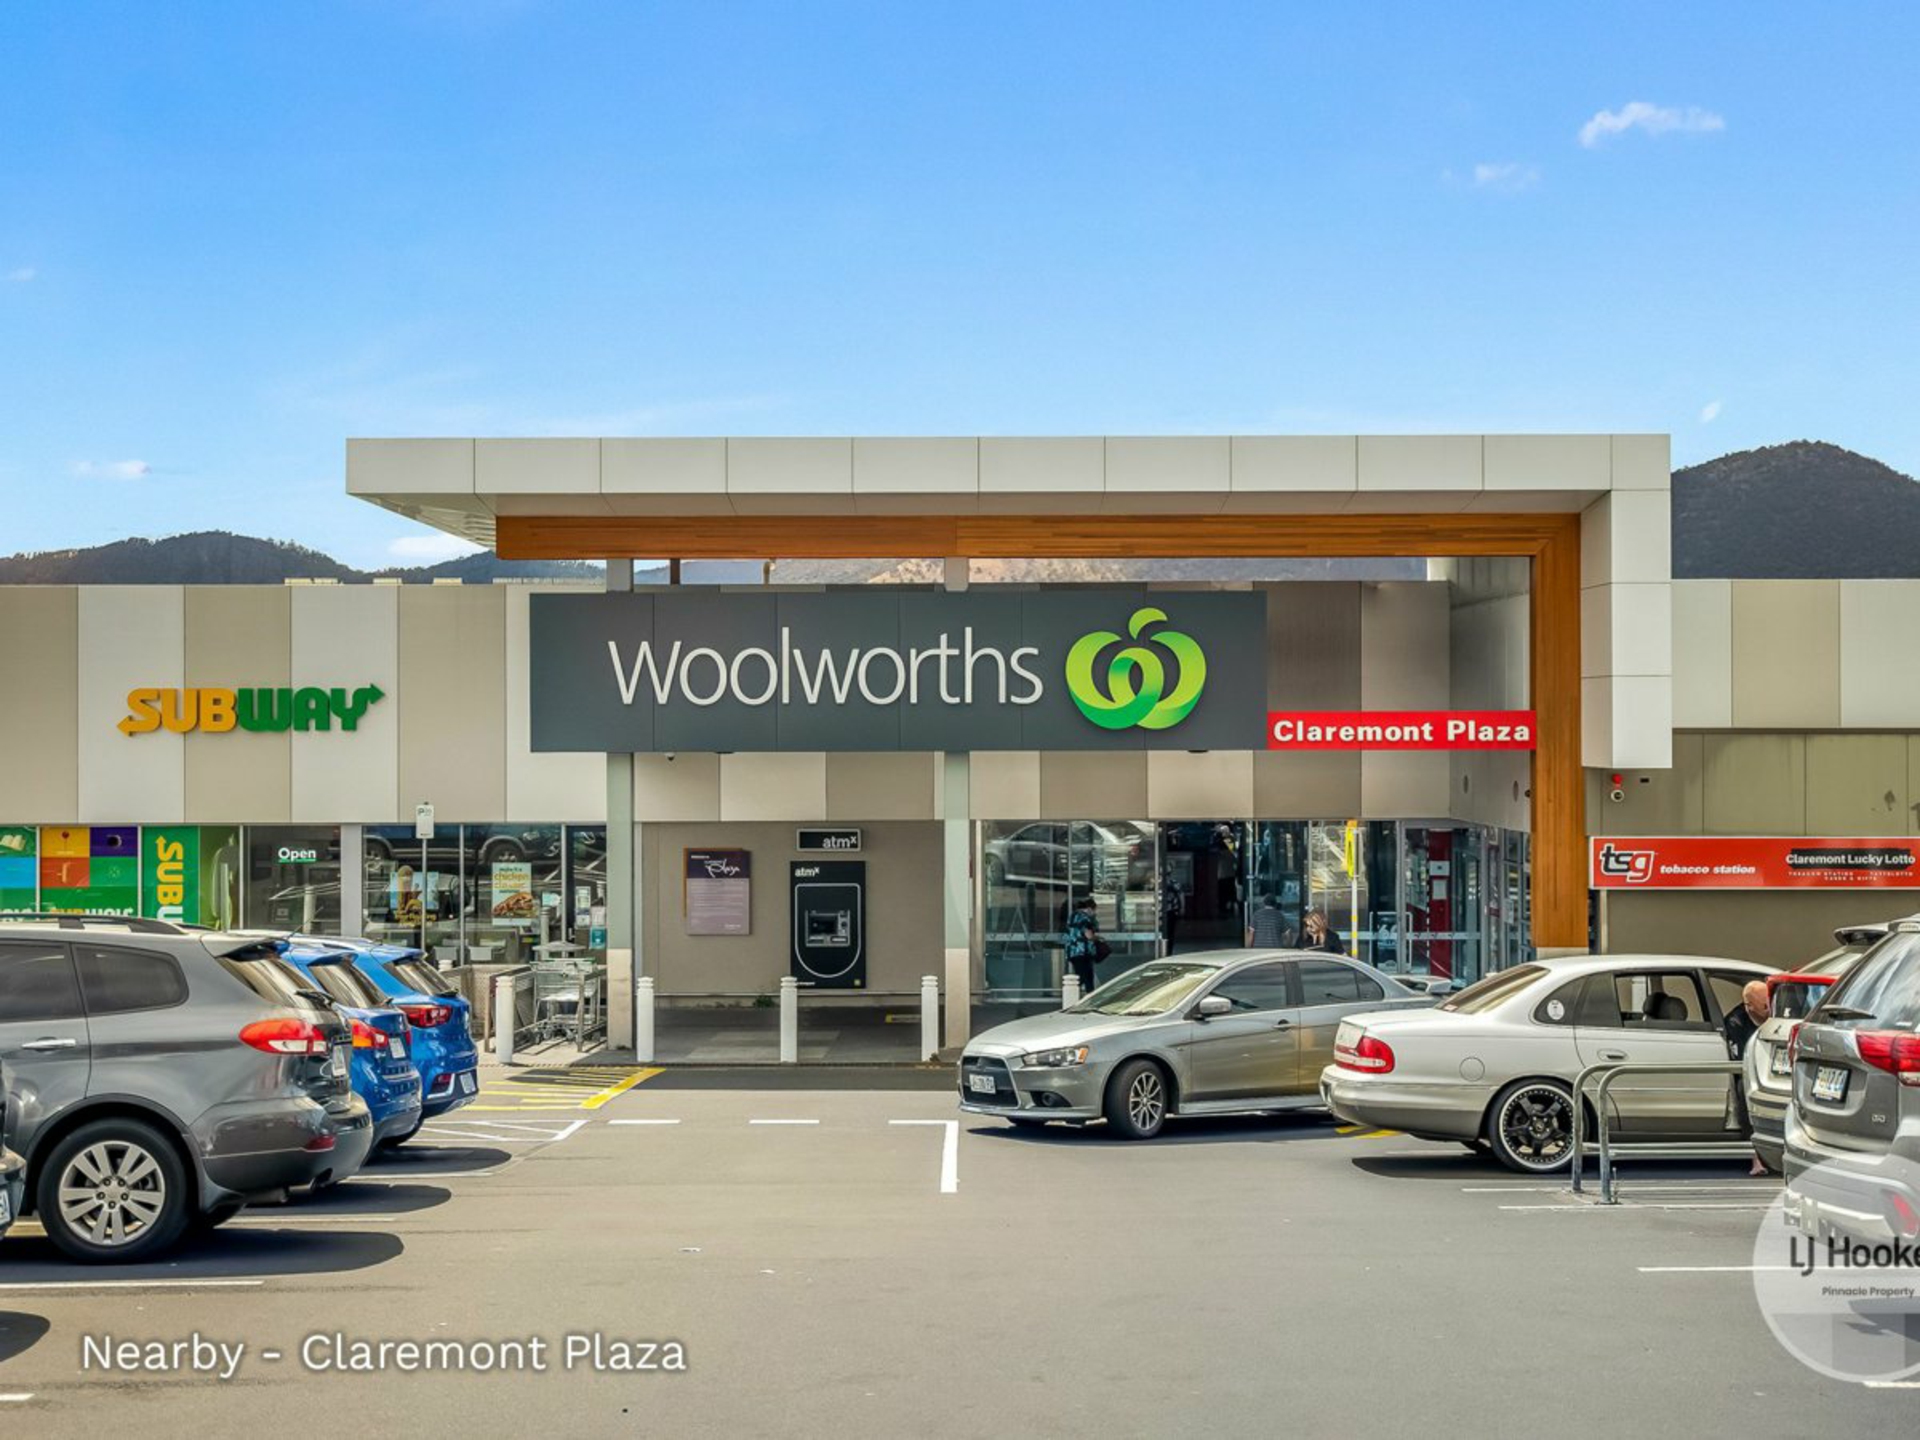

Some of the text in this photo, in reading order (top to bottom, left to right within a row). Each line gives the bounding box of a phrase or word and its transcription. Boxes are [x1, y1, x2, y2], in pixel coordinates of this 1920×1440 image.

[607, 626, 1043, 706] Woolworths
[117, 683, 385, 737] SUBWAY
[1273, 719, 1530, 743] Claremont Plaza
[278, 847, 317, 863] Open
[1600, 844, 1655, 882] tsg
[1785, 854, 1916, 866] Claremont Lucky Lotto
[1660, 864, 1756, 874] tobacco station
